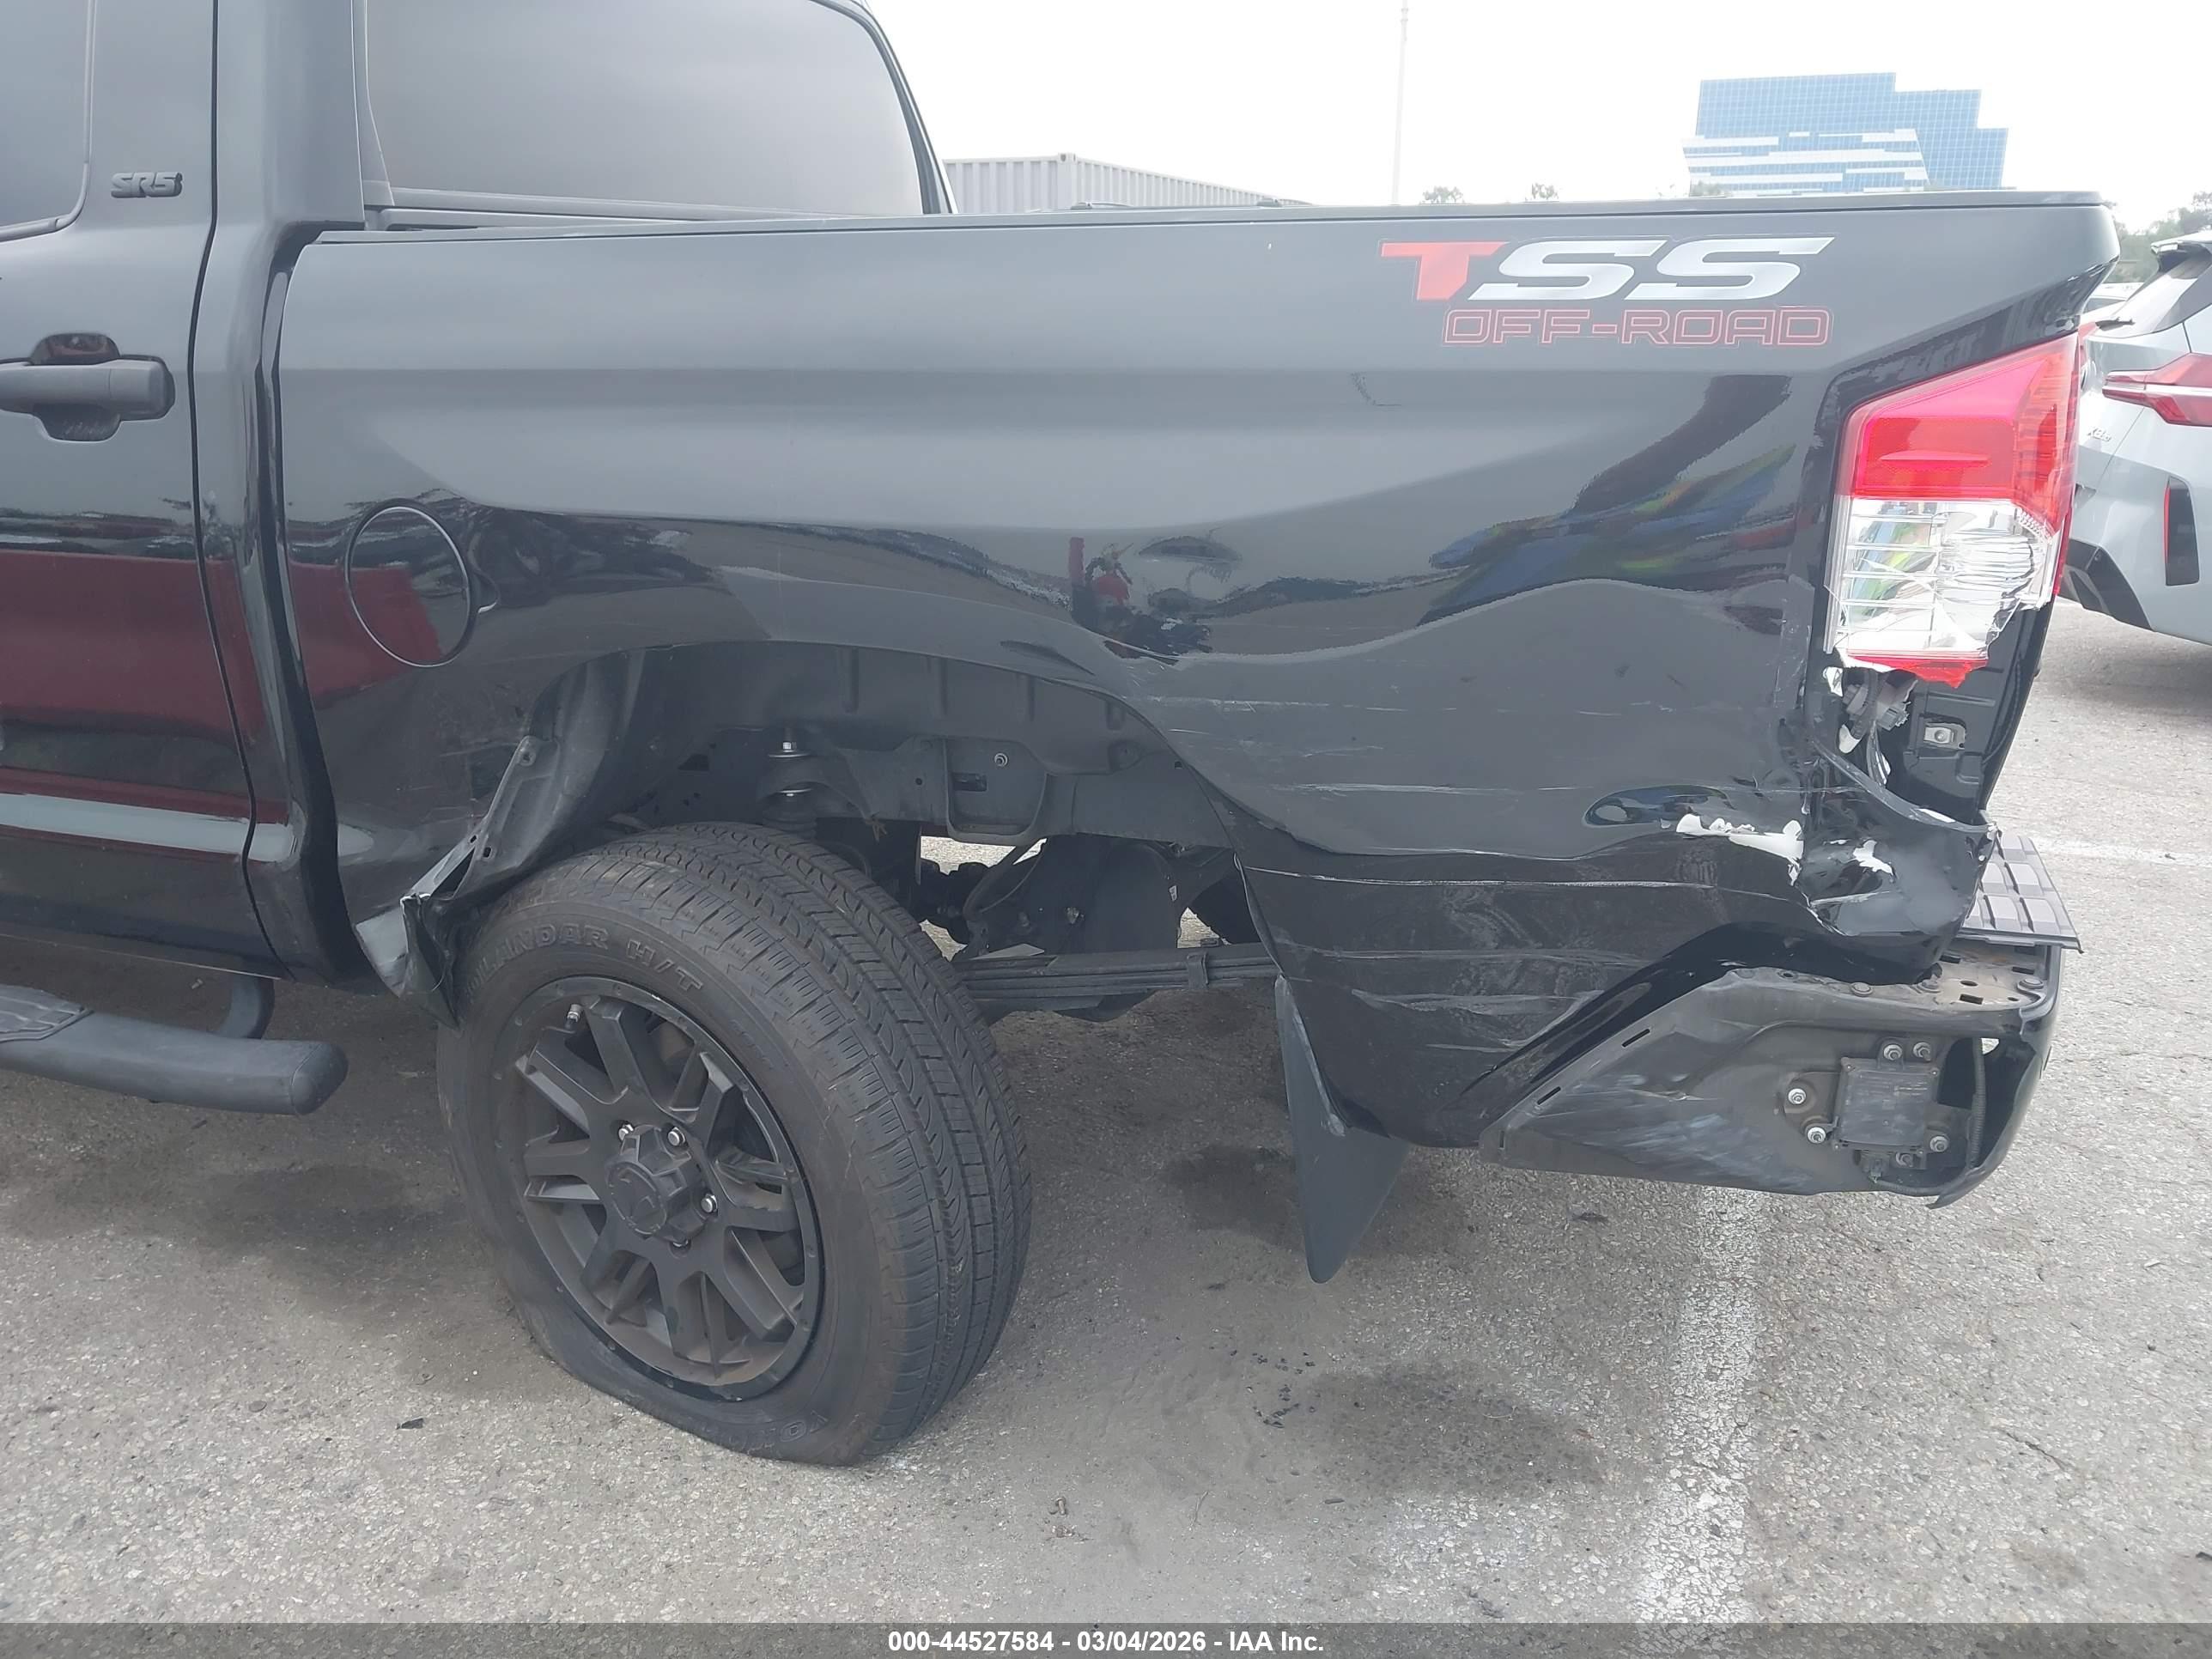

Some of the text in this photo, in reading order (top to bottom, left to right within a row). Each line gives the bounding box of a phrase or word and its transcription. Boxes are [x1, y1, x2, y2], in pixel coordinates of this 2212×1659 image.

[111, 172, 183, 199] SR5
[1381, 237, 1835, 301] TSS
[1444, 308, 1831, 345] OFF-ROAD
[627, 939, 704, 991] H/T
